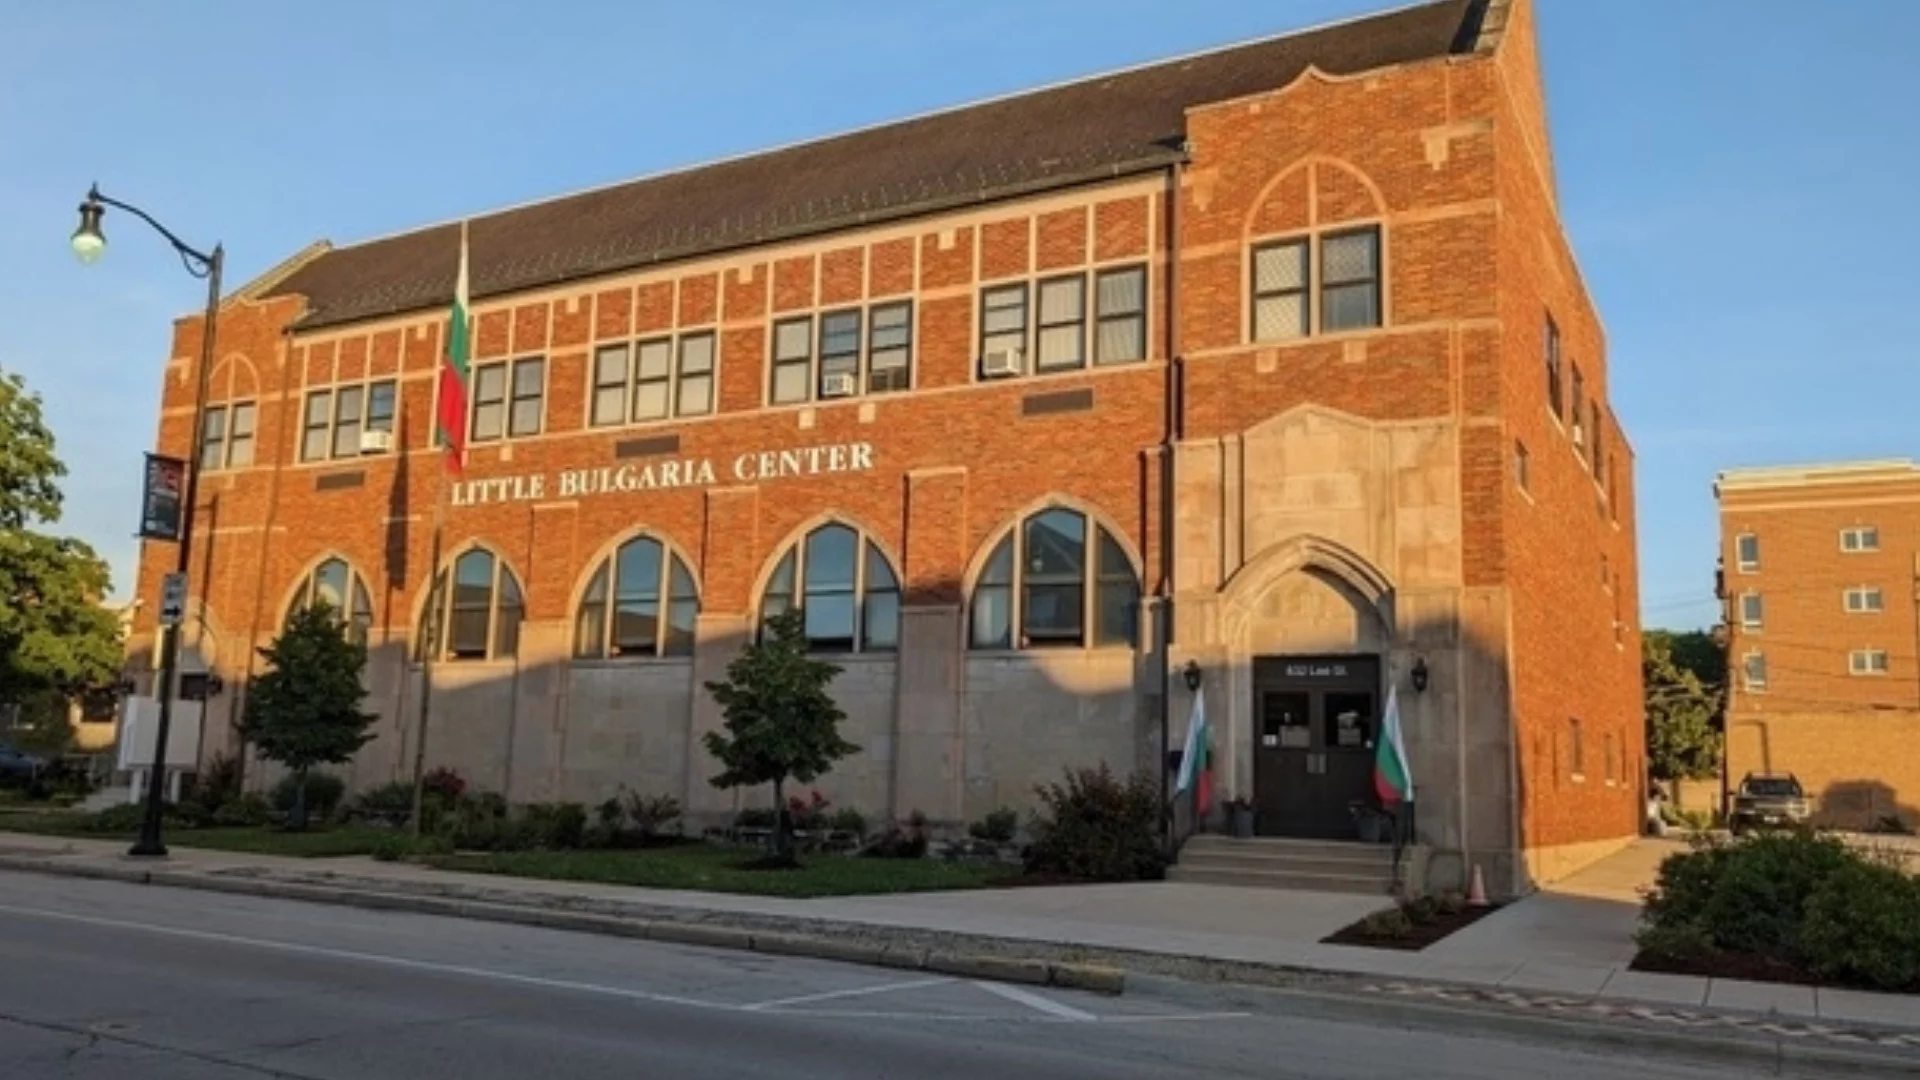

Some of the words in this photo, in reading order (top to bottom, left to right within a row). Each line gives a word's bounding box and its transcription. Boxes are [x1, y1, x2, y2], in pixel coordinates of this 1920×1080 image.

[451, 473, 544, 506] LITTLE
[559, 458, 716, 497] BULGARIA
[734, 441, 874, 481] CENTER
